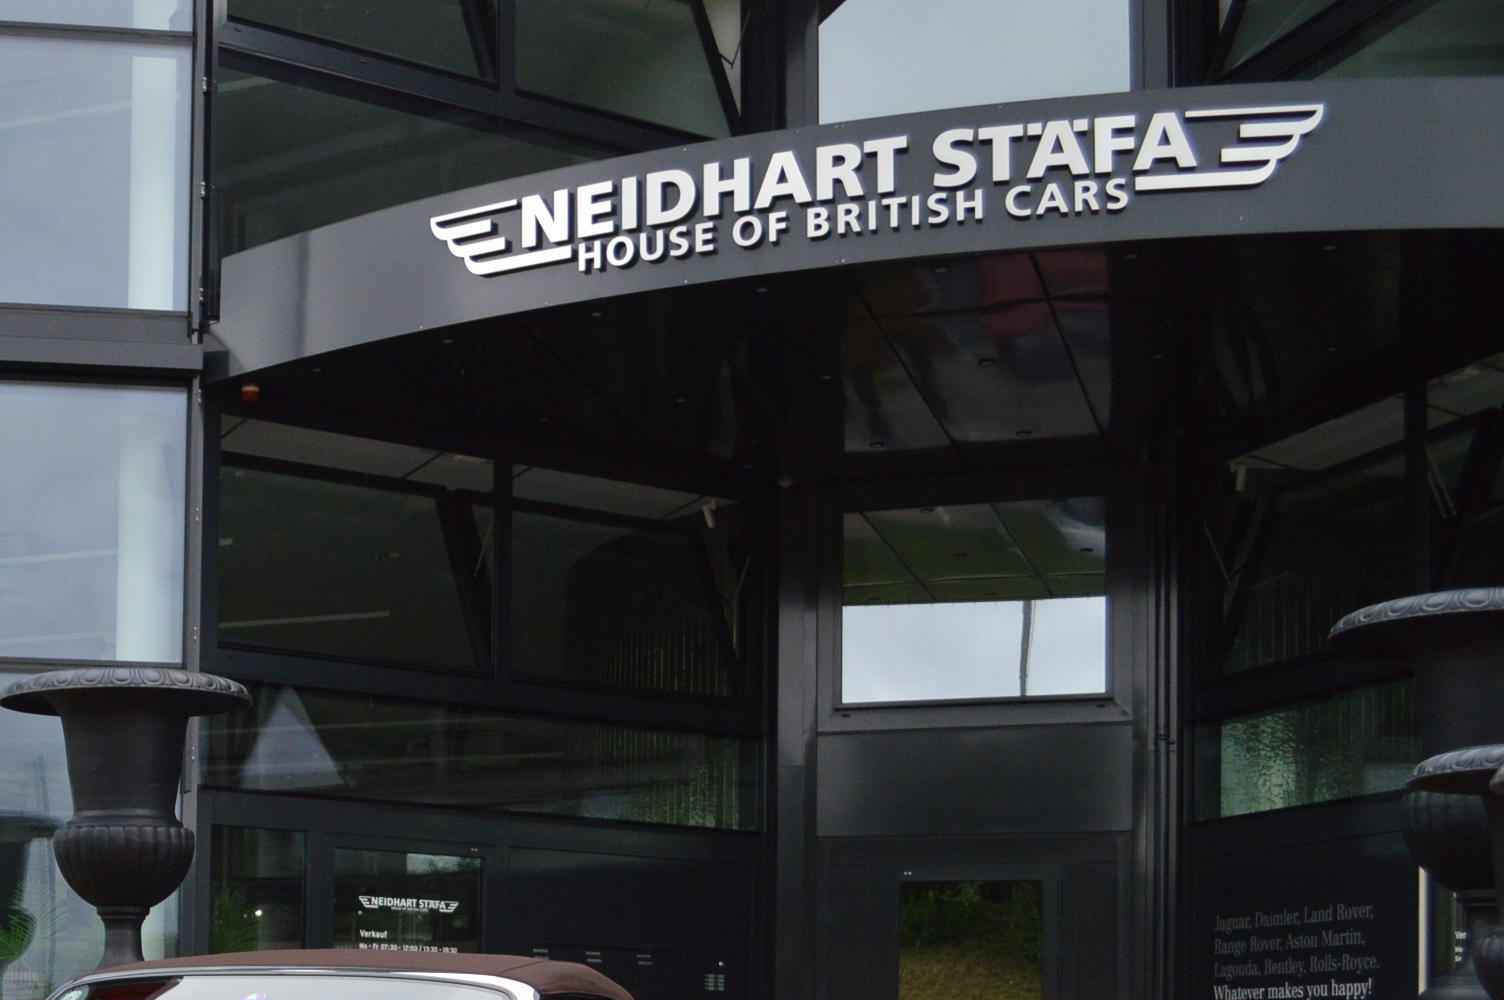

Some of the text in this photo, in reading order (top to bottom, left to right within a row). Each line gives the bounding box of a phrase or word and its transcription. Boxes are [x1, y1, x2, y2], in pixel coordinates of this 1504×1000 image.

[519, 112, 1198, 249] NEIDHART STÄFA
[577, 177, 1131, 273] HOUSE OF BRITISH CARS
[371, 896, 417, 908] NEIDHART
[1214, 903, 1374, 934] Jaguar, Daimler, Land Rover,
[359, 929, 387, 939] Verkauf
[1214, 928, 1365, 957] Range Rover, Aston Martin,
[1214, 953, 1380, 981] Lagonda, Bentley, Rolls-Royce.
[1213, 984, 1264, 1000] Whatever
[1267, 981, 1304, 1000] makes
[1331, 977, 1373, 1000] happy!
